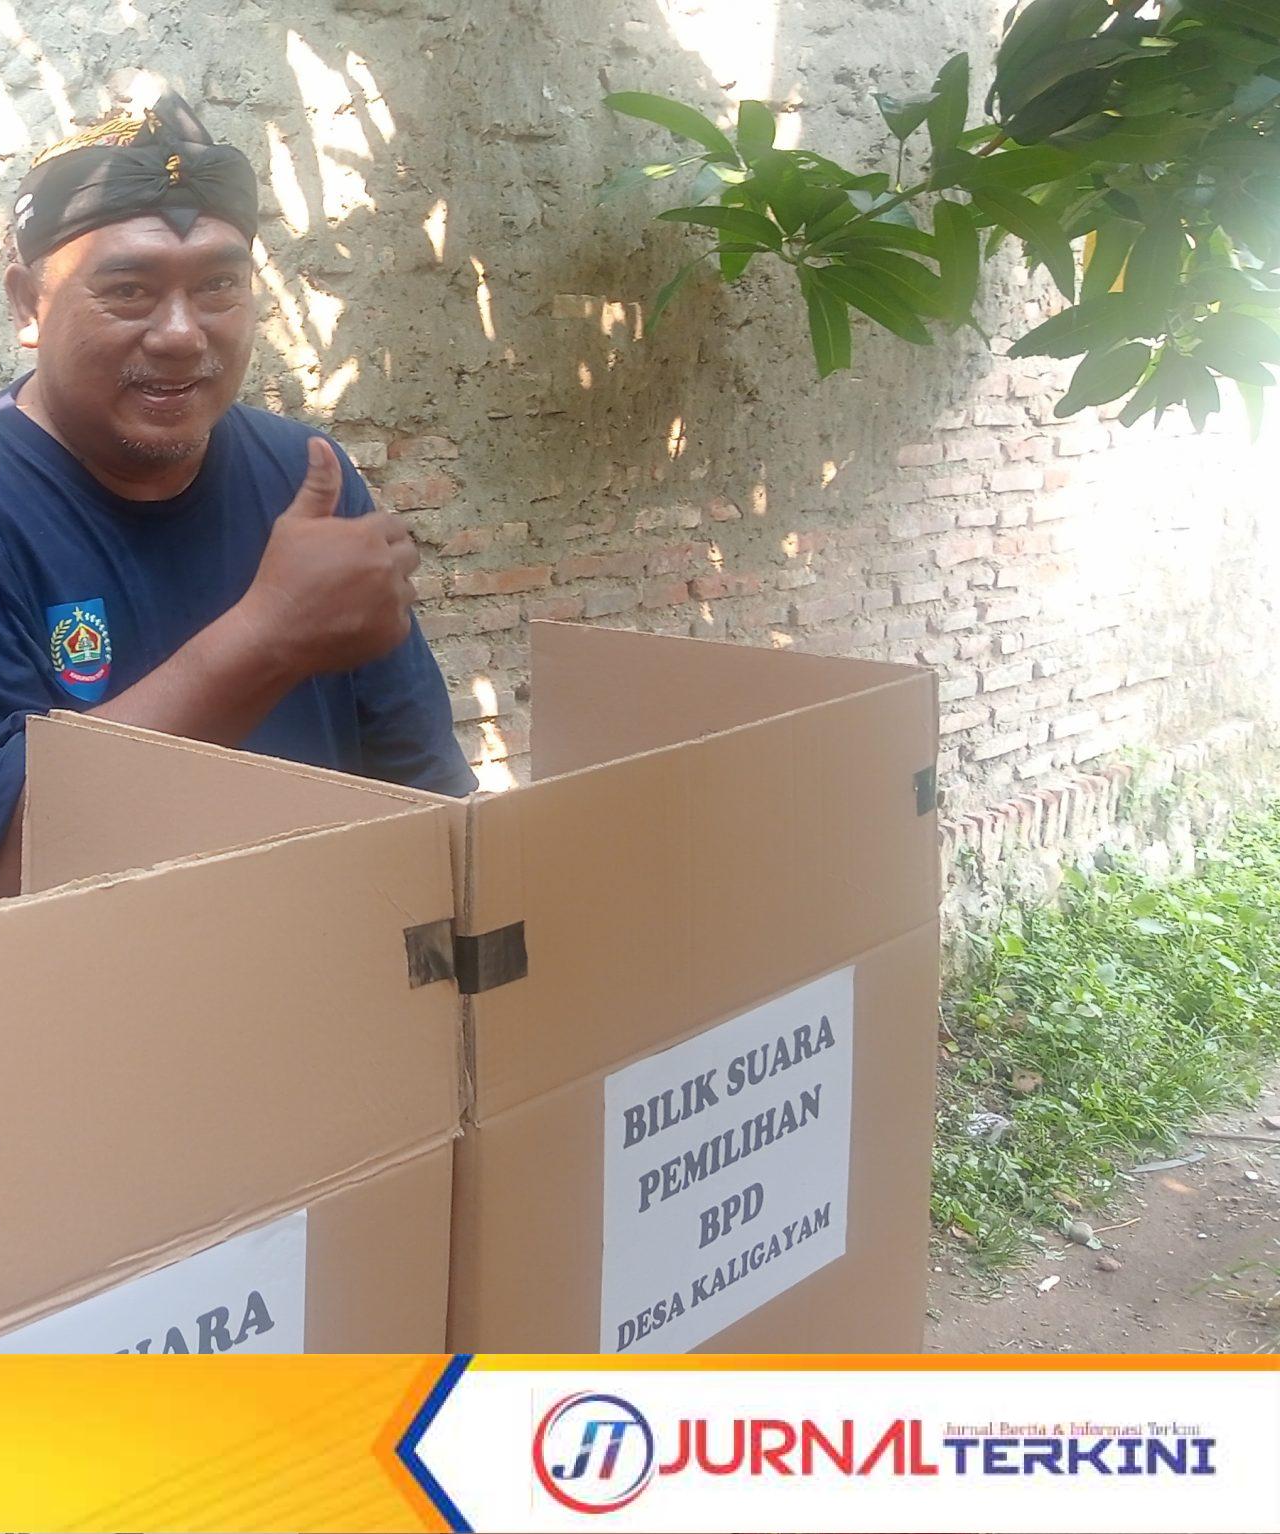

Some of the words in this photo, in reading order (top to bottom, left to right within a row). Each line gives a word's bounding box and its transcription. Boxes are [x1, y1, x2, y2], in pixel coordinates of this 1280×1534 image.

[623, 1069, 719, 1149] BILIK
[726, 1015, 836, 1097] SUARA
[638, 1084, 822, 1213] PEMILIHAN
[616, 1292, 685, 1352] DESA
[690, 1202, 831, 1308] KALIGAYAM
[699, 1182, 765, 1249] BPD
[114, 1290, 275, 1354] ARA
